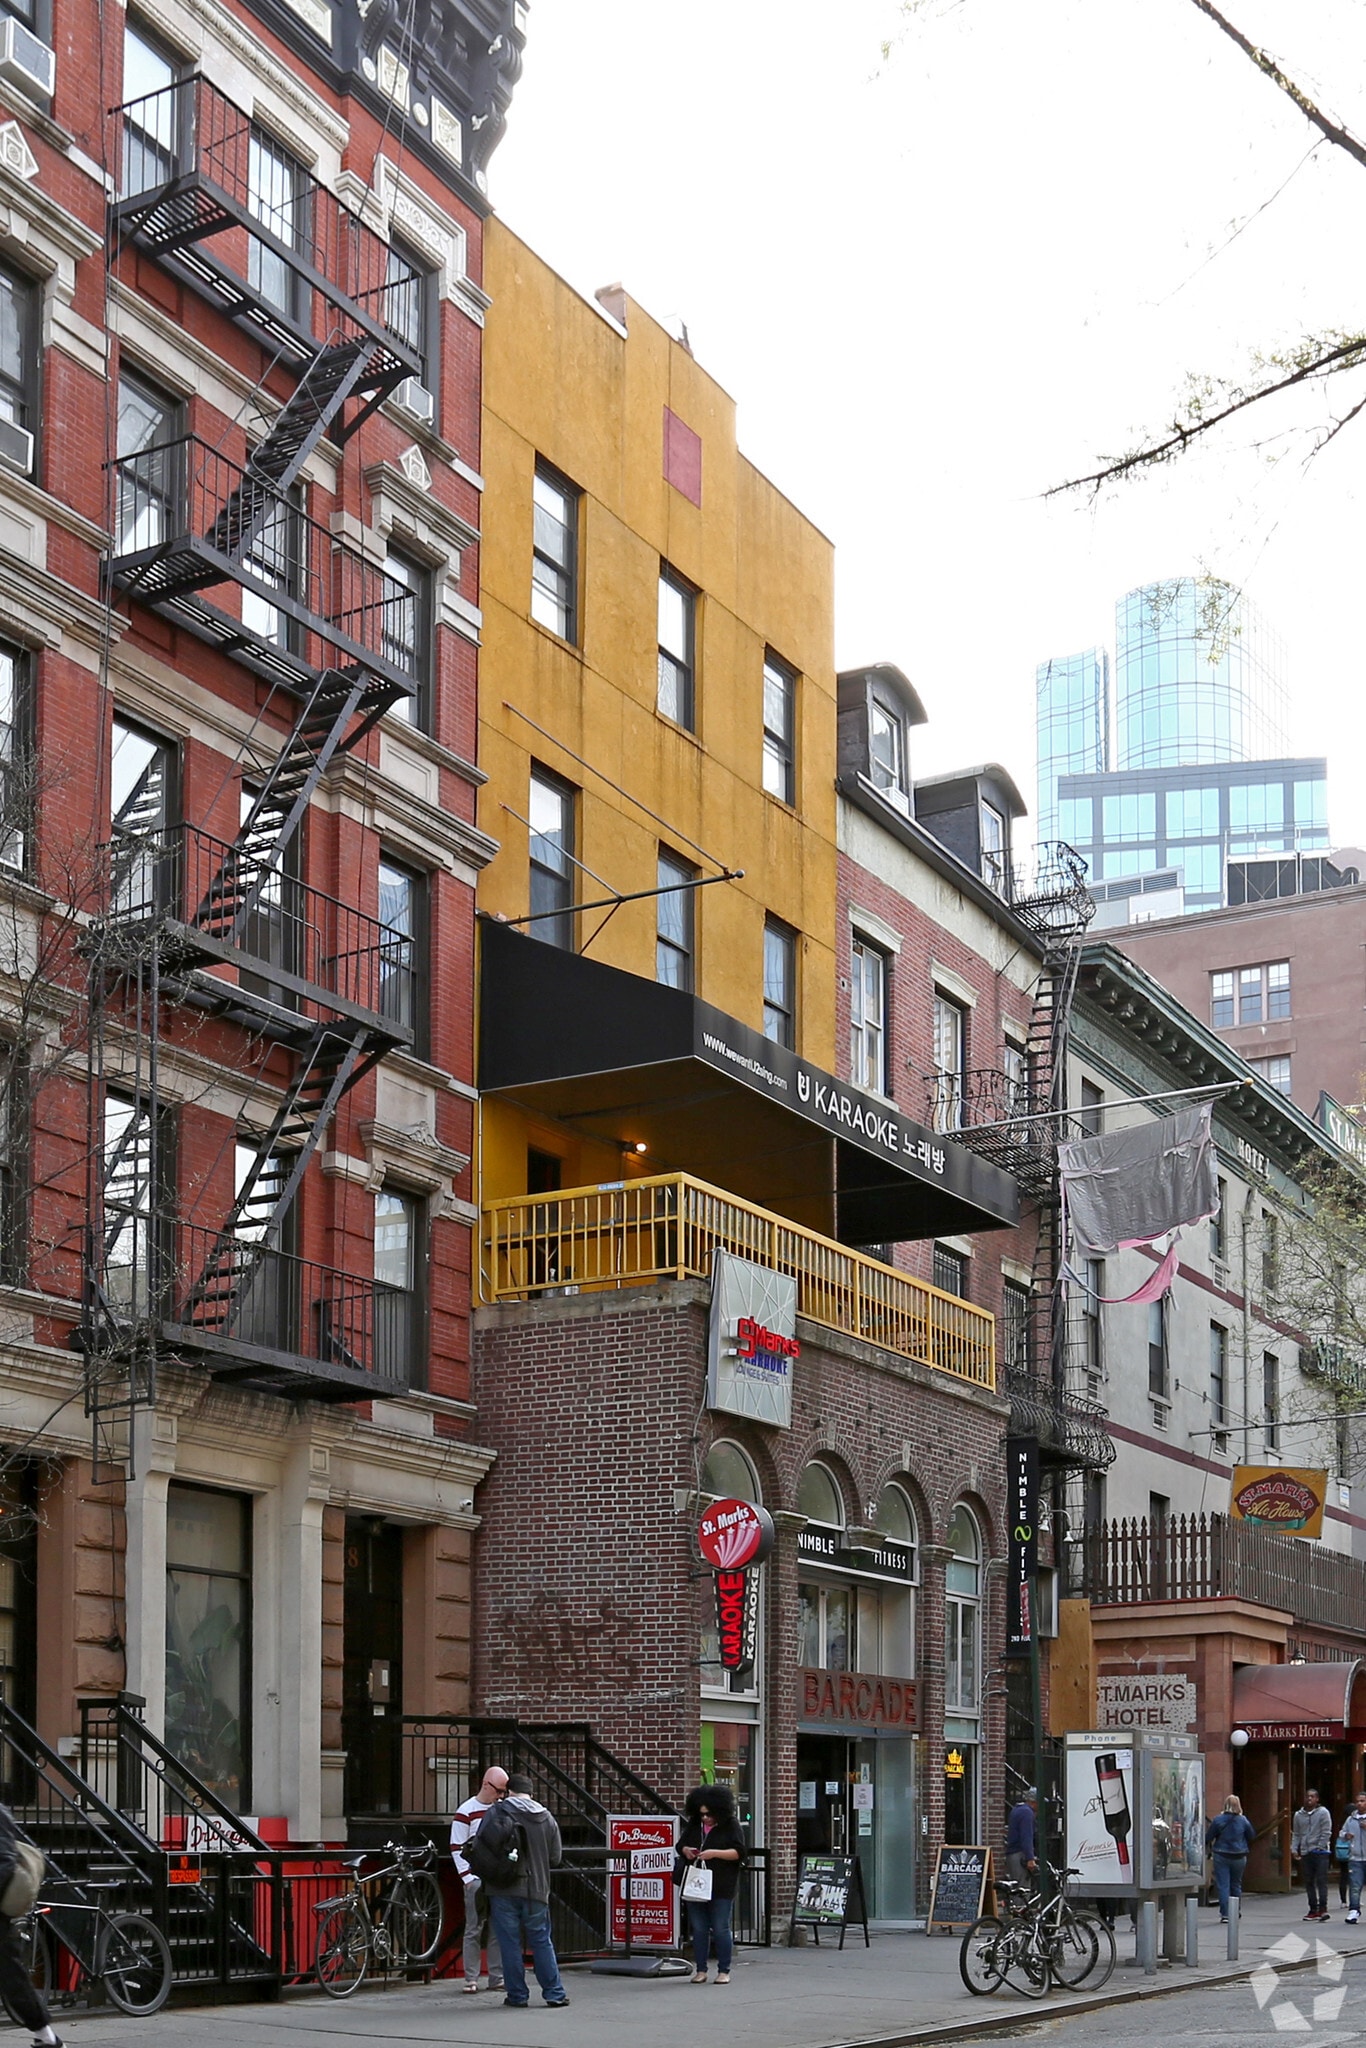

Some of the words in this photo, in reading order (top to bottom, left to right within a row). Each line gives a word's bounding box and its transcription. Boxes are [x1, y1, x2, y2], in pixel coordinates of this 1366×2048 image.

[815, 1081, 898, 1152] KARAOKE
[903, 1133, 946, 1175] 노래방
[1238, 1137, 1271, 1180] HOTEL
[1019, 1453, 1028, 1520] NIMBLE
[702, 1519, 717, 1536] St.
[717, 1505, 750, 1529] Marks
[1246, 1499, 1270, 1516] Ale
[1268, 1500, 1305, 1518] House
[797, 1533, 835, 1555] NIMBLE
[874, 1551, 906, 1570] FITNESS
[718, 1572, 744, 1666] KARAOKE
[747, 1567, 760, 1659] KARAOKE
[804, 1672, 917, 1725] BARCADE
[1106, 1708, 1172, 1725] HOTEL
[614, 1859, 627, 1870] MA
[633, 1855, 640, 1870] &
[641, 1852, 672, 1869] iPHONE
[941, 1864, 982, 1873] BARCADE
[631, 1881, 659, 1898] EPAIR
